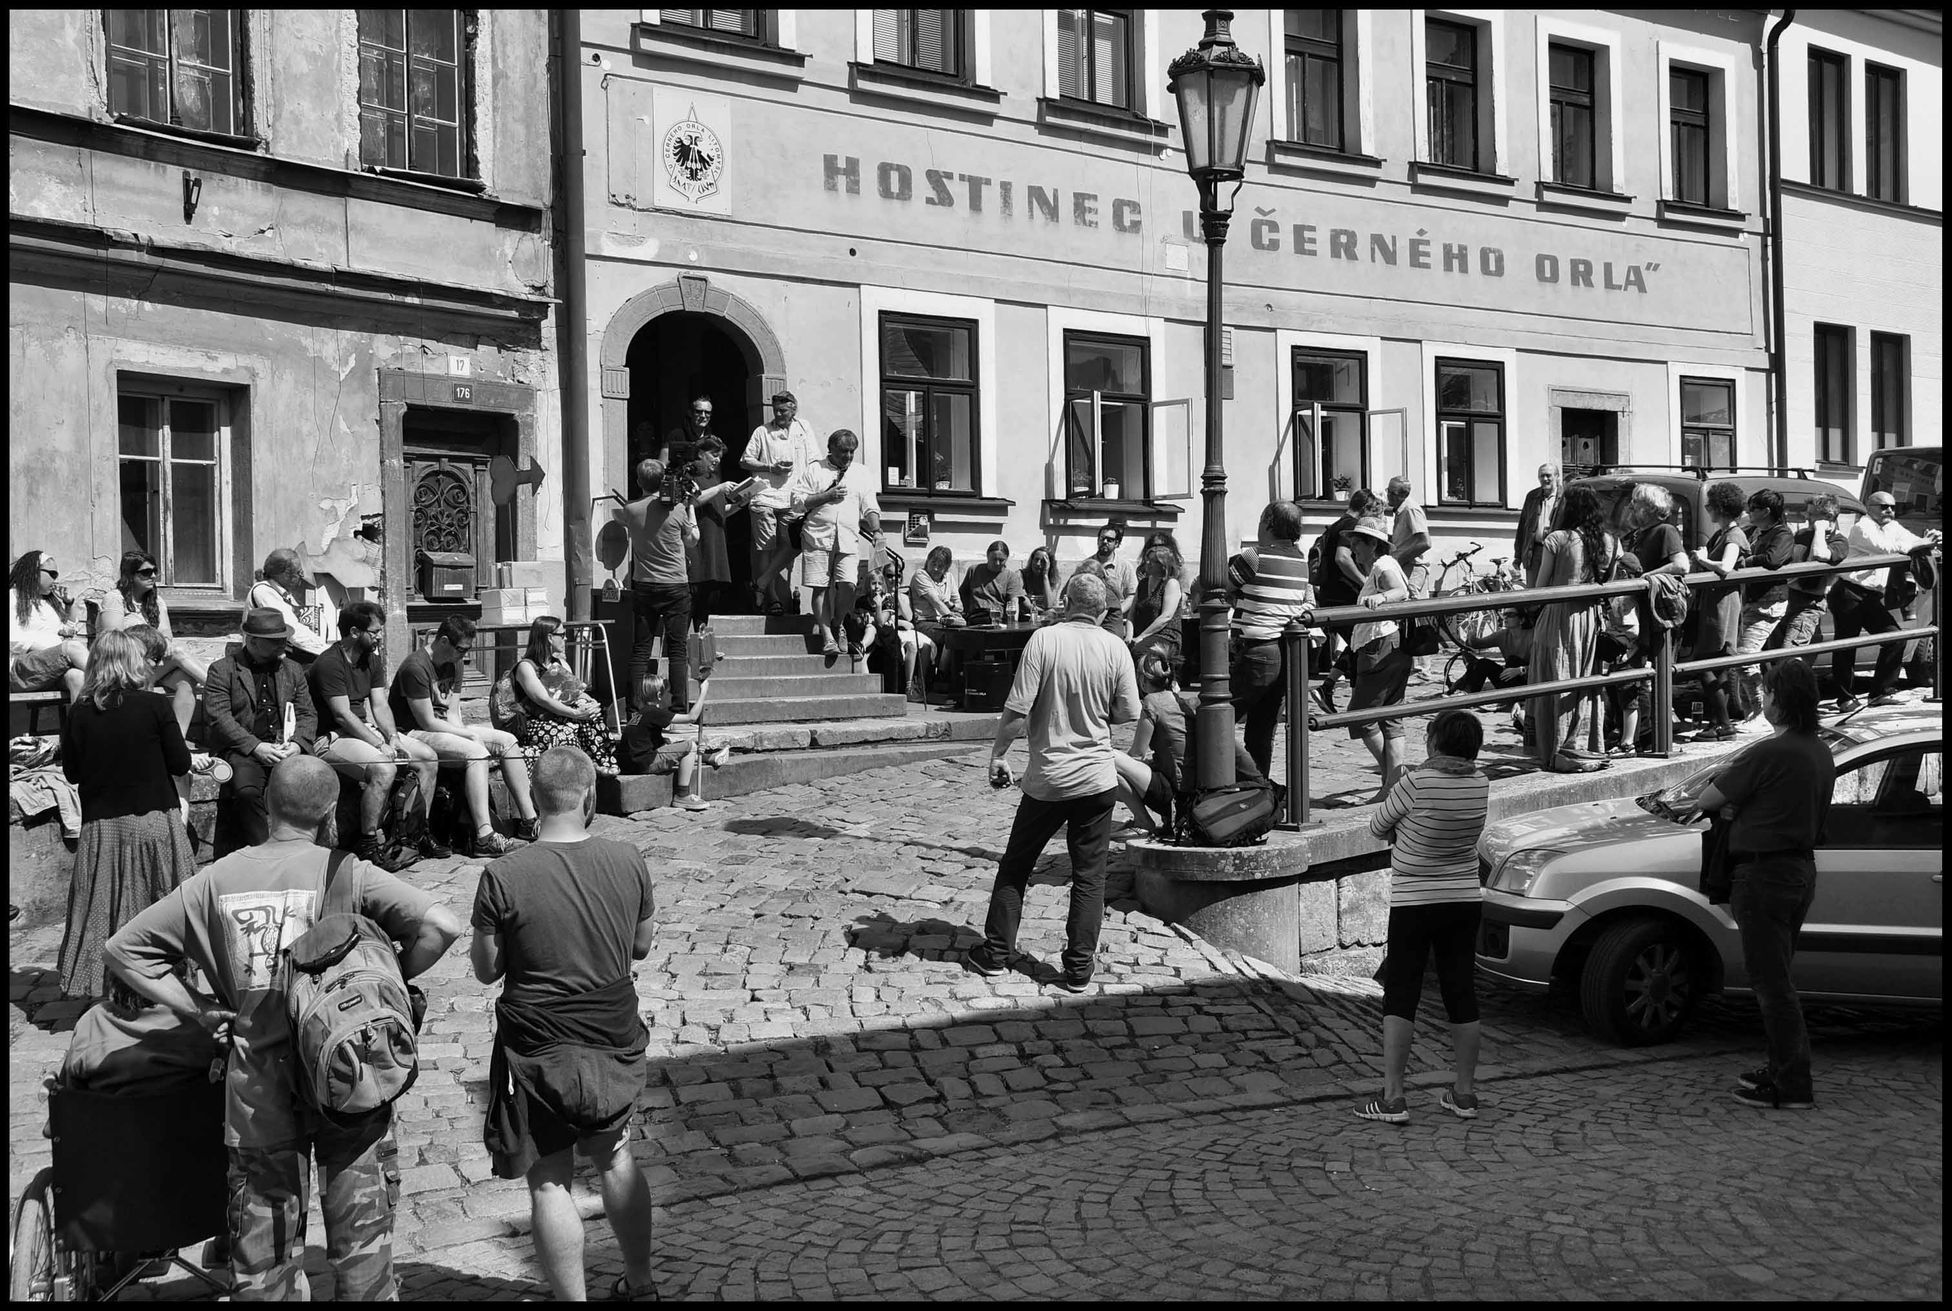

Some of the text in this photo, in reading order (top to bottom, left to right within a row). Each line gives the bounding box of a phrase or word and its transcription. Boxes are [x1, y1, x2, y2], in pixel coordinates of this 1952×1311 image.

[823, 153, 1143, 234] HOSTINEC
[1249, 205, 1506, 278] ČERNÉHO
[456, 359, 465, 371] 17
[456, 387, 470, 399] 176
